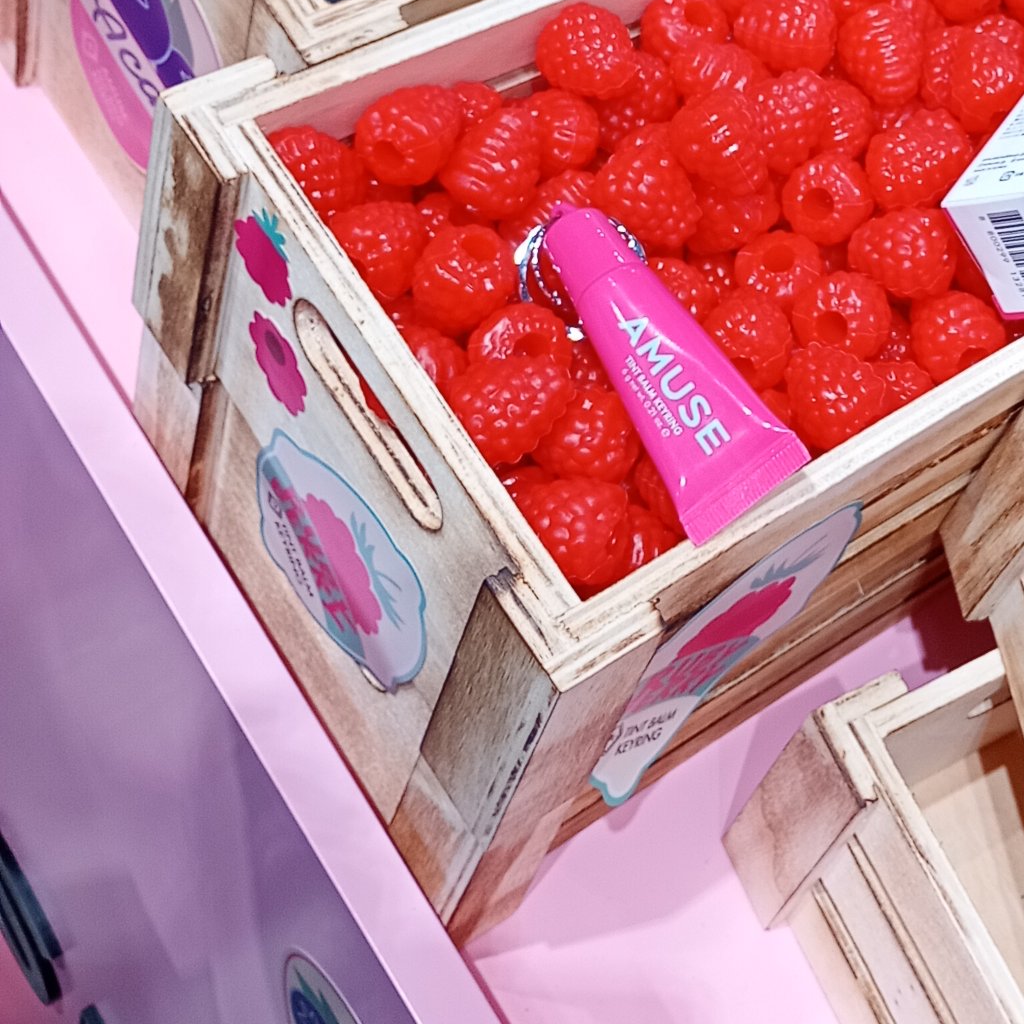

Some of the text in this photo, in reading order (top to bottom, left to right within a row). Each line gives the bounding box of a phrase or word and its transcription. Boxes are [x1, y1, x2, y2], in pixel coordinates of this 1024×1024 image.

[619, 316, 731, 456] AMUSE
[624, 354, 683, 436] TINT BALM KEYRING
[643, 400, 658, 417] 0.21
